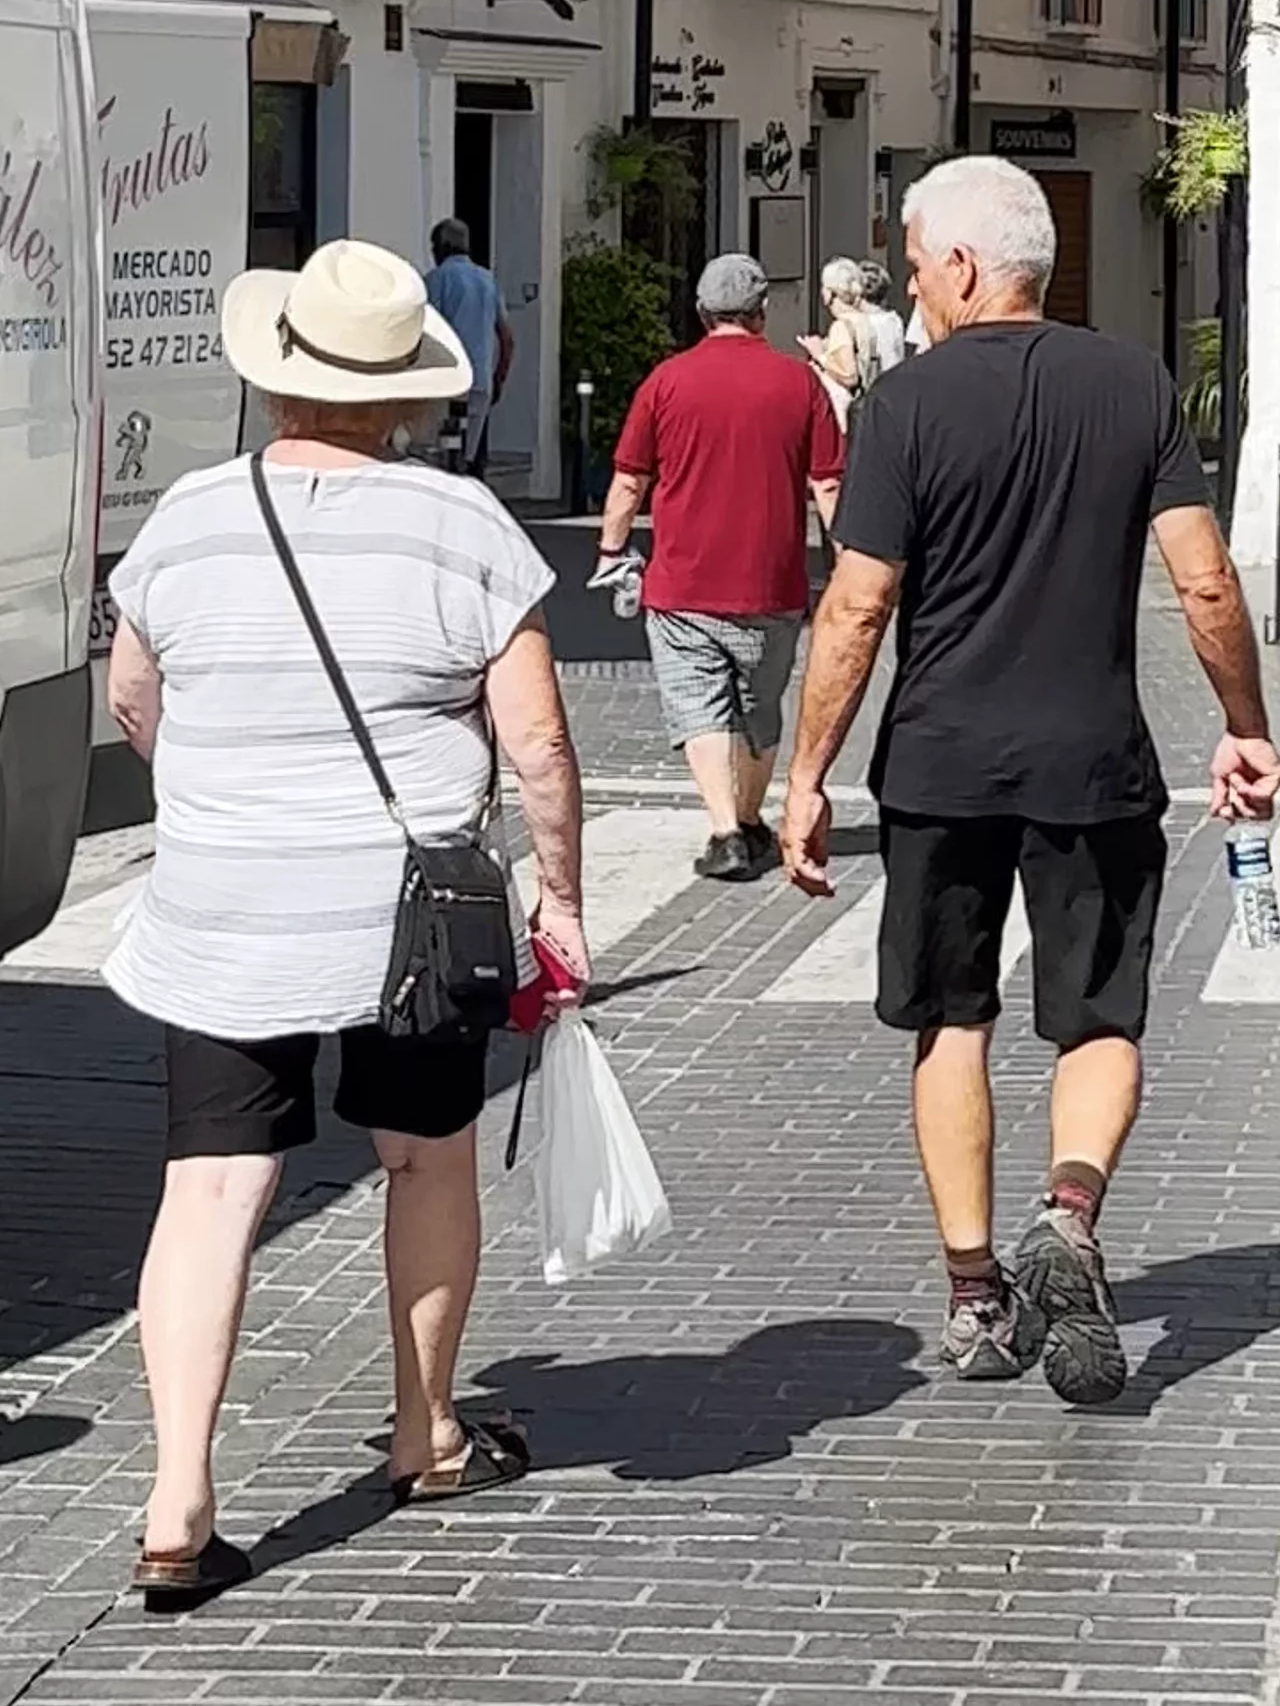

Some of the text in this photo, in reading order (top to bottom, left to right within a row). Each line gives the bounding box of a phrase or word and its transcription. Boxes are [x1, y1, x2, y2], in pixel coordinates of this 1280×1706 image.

[112, 248, 213, 281] MERCADO
[139, 335, 169, 368] 47
[172, 334, 192, 364] 21
